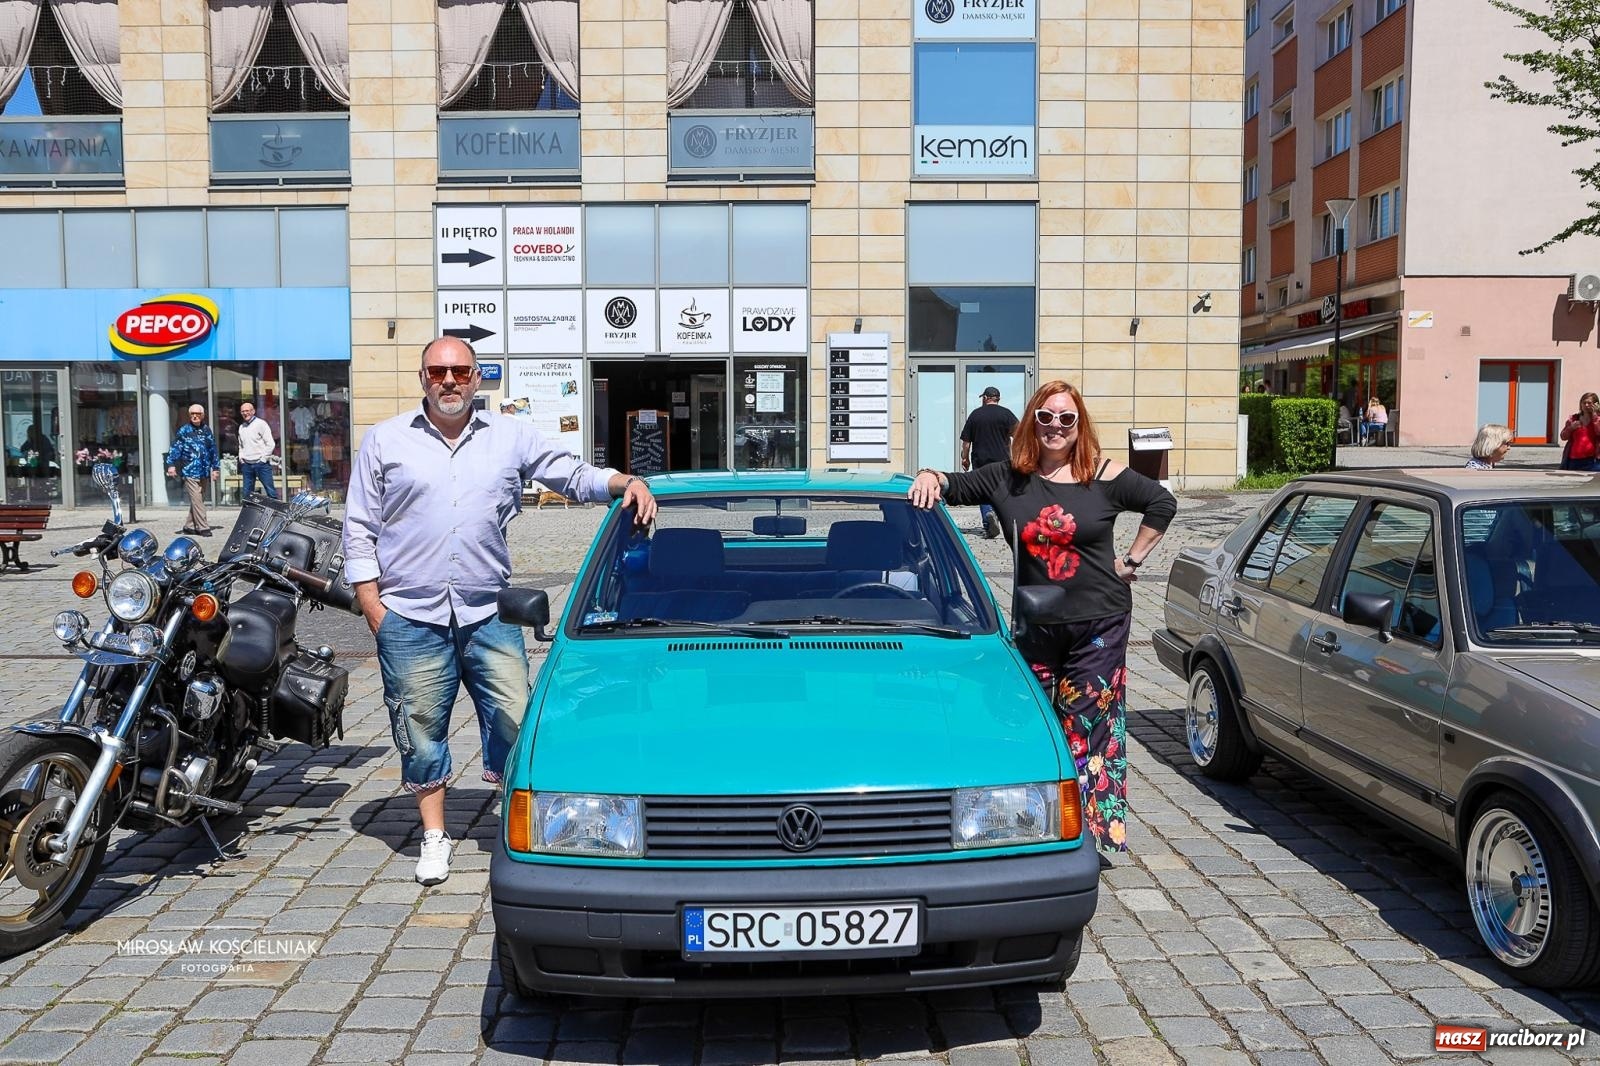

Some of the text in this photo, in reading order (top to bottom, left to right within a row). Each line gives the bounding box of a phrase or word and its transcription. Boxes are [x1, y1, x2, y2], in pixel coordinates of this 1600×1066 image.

[725, 127, 799, 142] FRYZJER
[455, 131, 562, 155] KOFEINKA
[453, 227, 497, 240] PIĘTRO
[513, 226, 575, 235] PRACA W HOLANDII
[513, 244, 563, 254] COVEBO
[452, 302, 496, 316] PIĘTRO
[742, 307, 796, 315] PRAWDZIWE
[125, 314, 201, 334] PEPCO
[742, 316, 796, 332] LODY
[604, 332, 637, 341] FRYZJER
[676, 332, 712, 340] KOFEINKA
[541, 362, 572, 370] KOFEINKA
[707, 908, 913, 948] SRC 05827
[687, 934, 702, 945] PL
